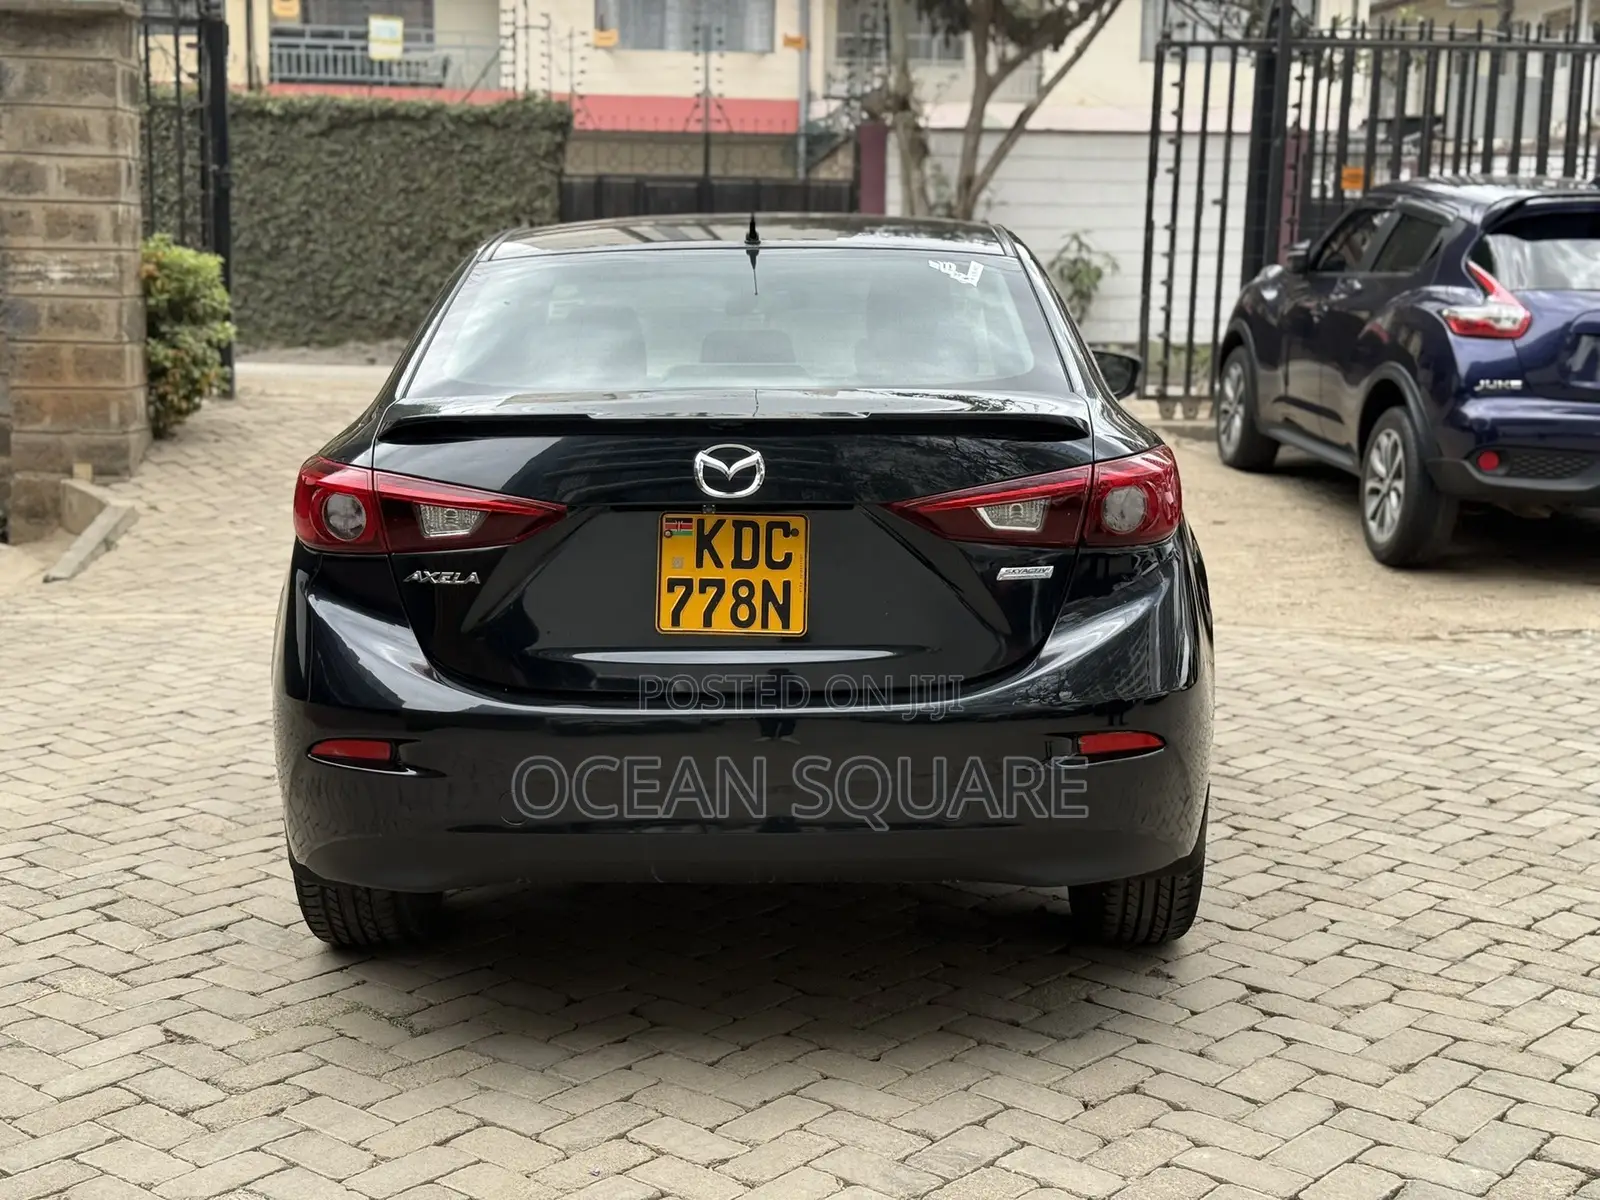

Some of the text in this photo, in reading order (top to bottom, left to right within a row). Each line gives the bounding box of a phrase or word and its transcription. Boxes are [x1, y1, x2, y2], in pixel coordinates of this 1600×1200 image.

[1473, 379, 1522, 391] JUKE
[695, 518, 793, 570] KDC
[403, 570, 480, 584] AXELA
[666, 577, 791, 630] 778N
